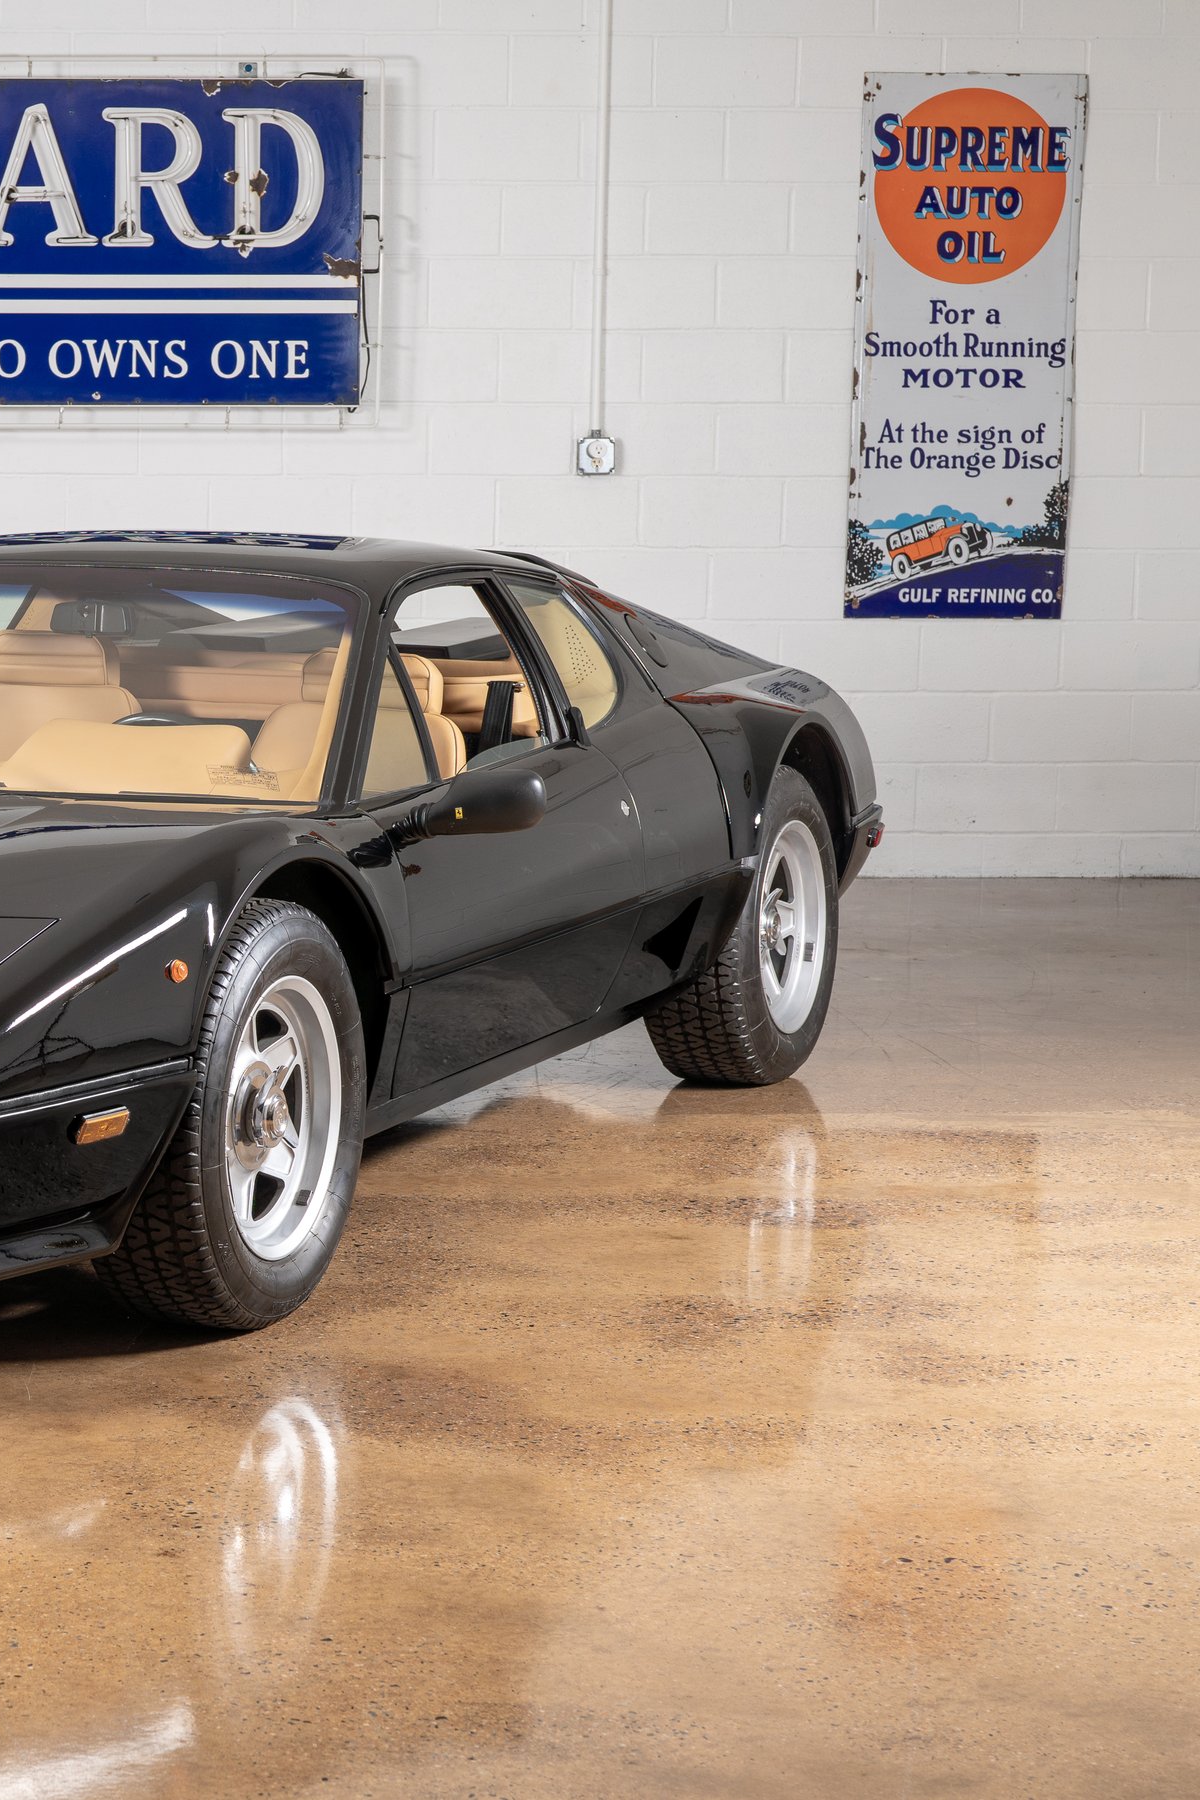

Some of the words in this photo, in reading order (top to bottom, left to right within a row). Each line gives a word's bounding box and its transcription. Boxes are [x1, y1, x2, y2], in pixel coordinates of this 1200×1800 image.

[872, 113, 1071, 173] SUPREME
[914, 186, 1023, 220] AUTO
[936, 230, 1006, 264] OIL
[929, 299, 975, 325] For
[986, 308, 1001, 325] a
[48, 339, 189, 379] OWNS
[211, 340, 310, 379] ONE
[864, 332, 958, 358] Smooth
[963, 333, 1066, 368] Running
[902, 368, 1026, 388] MOTOR
[878, 418, 904, 443] At
[911, 422, 949, 443] the
[957, 425, 1012, 450] sign
[1021, 423, 1046, 444] of
[863, 447, 903, 469] The
[910, 447, 996, 477] Orange
[1002, 448, 1060, 469] Disc
[898, 588, 942, 603] GULF
[947, 588, 1026, 603] REFINING
[1031, 588, 1057, 603] CO.
